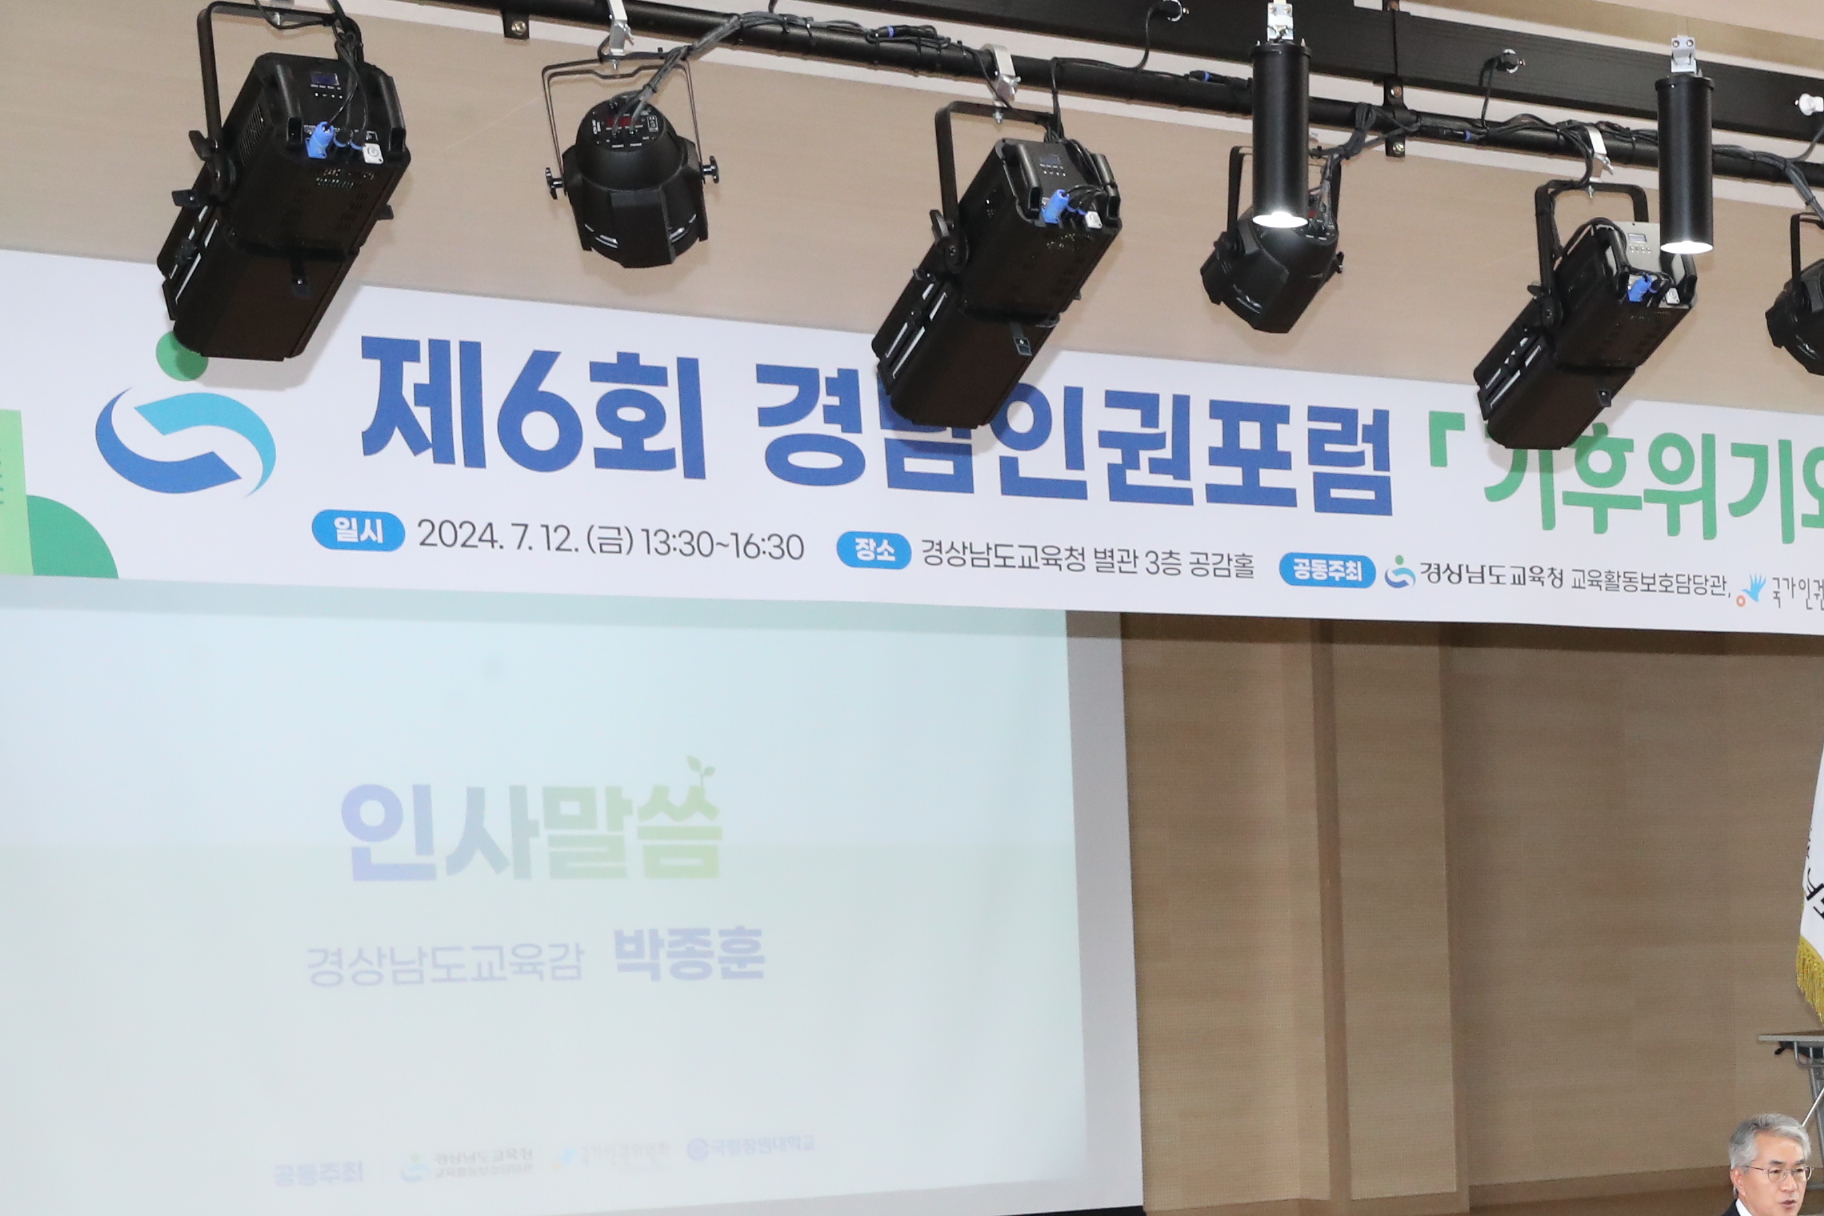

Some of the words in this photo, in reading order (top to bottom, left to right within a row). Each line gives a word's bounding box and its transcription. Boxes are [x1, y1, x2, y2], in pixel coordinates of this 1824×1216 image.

[361, 335, 706, 480] 제6회
[333, 516, 385, 545] 일시
[641, 528, 805, 560] 13:30~16:30
[854, 537, 897, 562] 장소
[921, 539, 1086, 573] 경상남도교육청
[1093, 547, 1139, 576] 별관
[1145, 551, 1182, 577] 3층
[1188, 551, 1256, 580] 공감홀
[1293, 557, 1363, 583] 공동주최
[1420, 562, 1565, 590] 경상남도교육청
[1571, 568, 1732, 598] 교육활동보호담당관,
[340, 782, 723, 883] 인사말씀
[304, 941, 586, 988] 경상남도교육감
[612, 925, 767, 982] 박종훈
